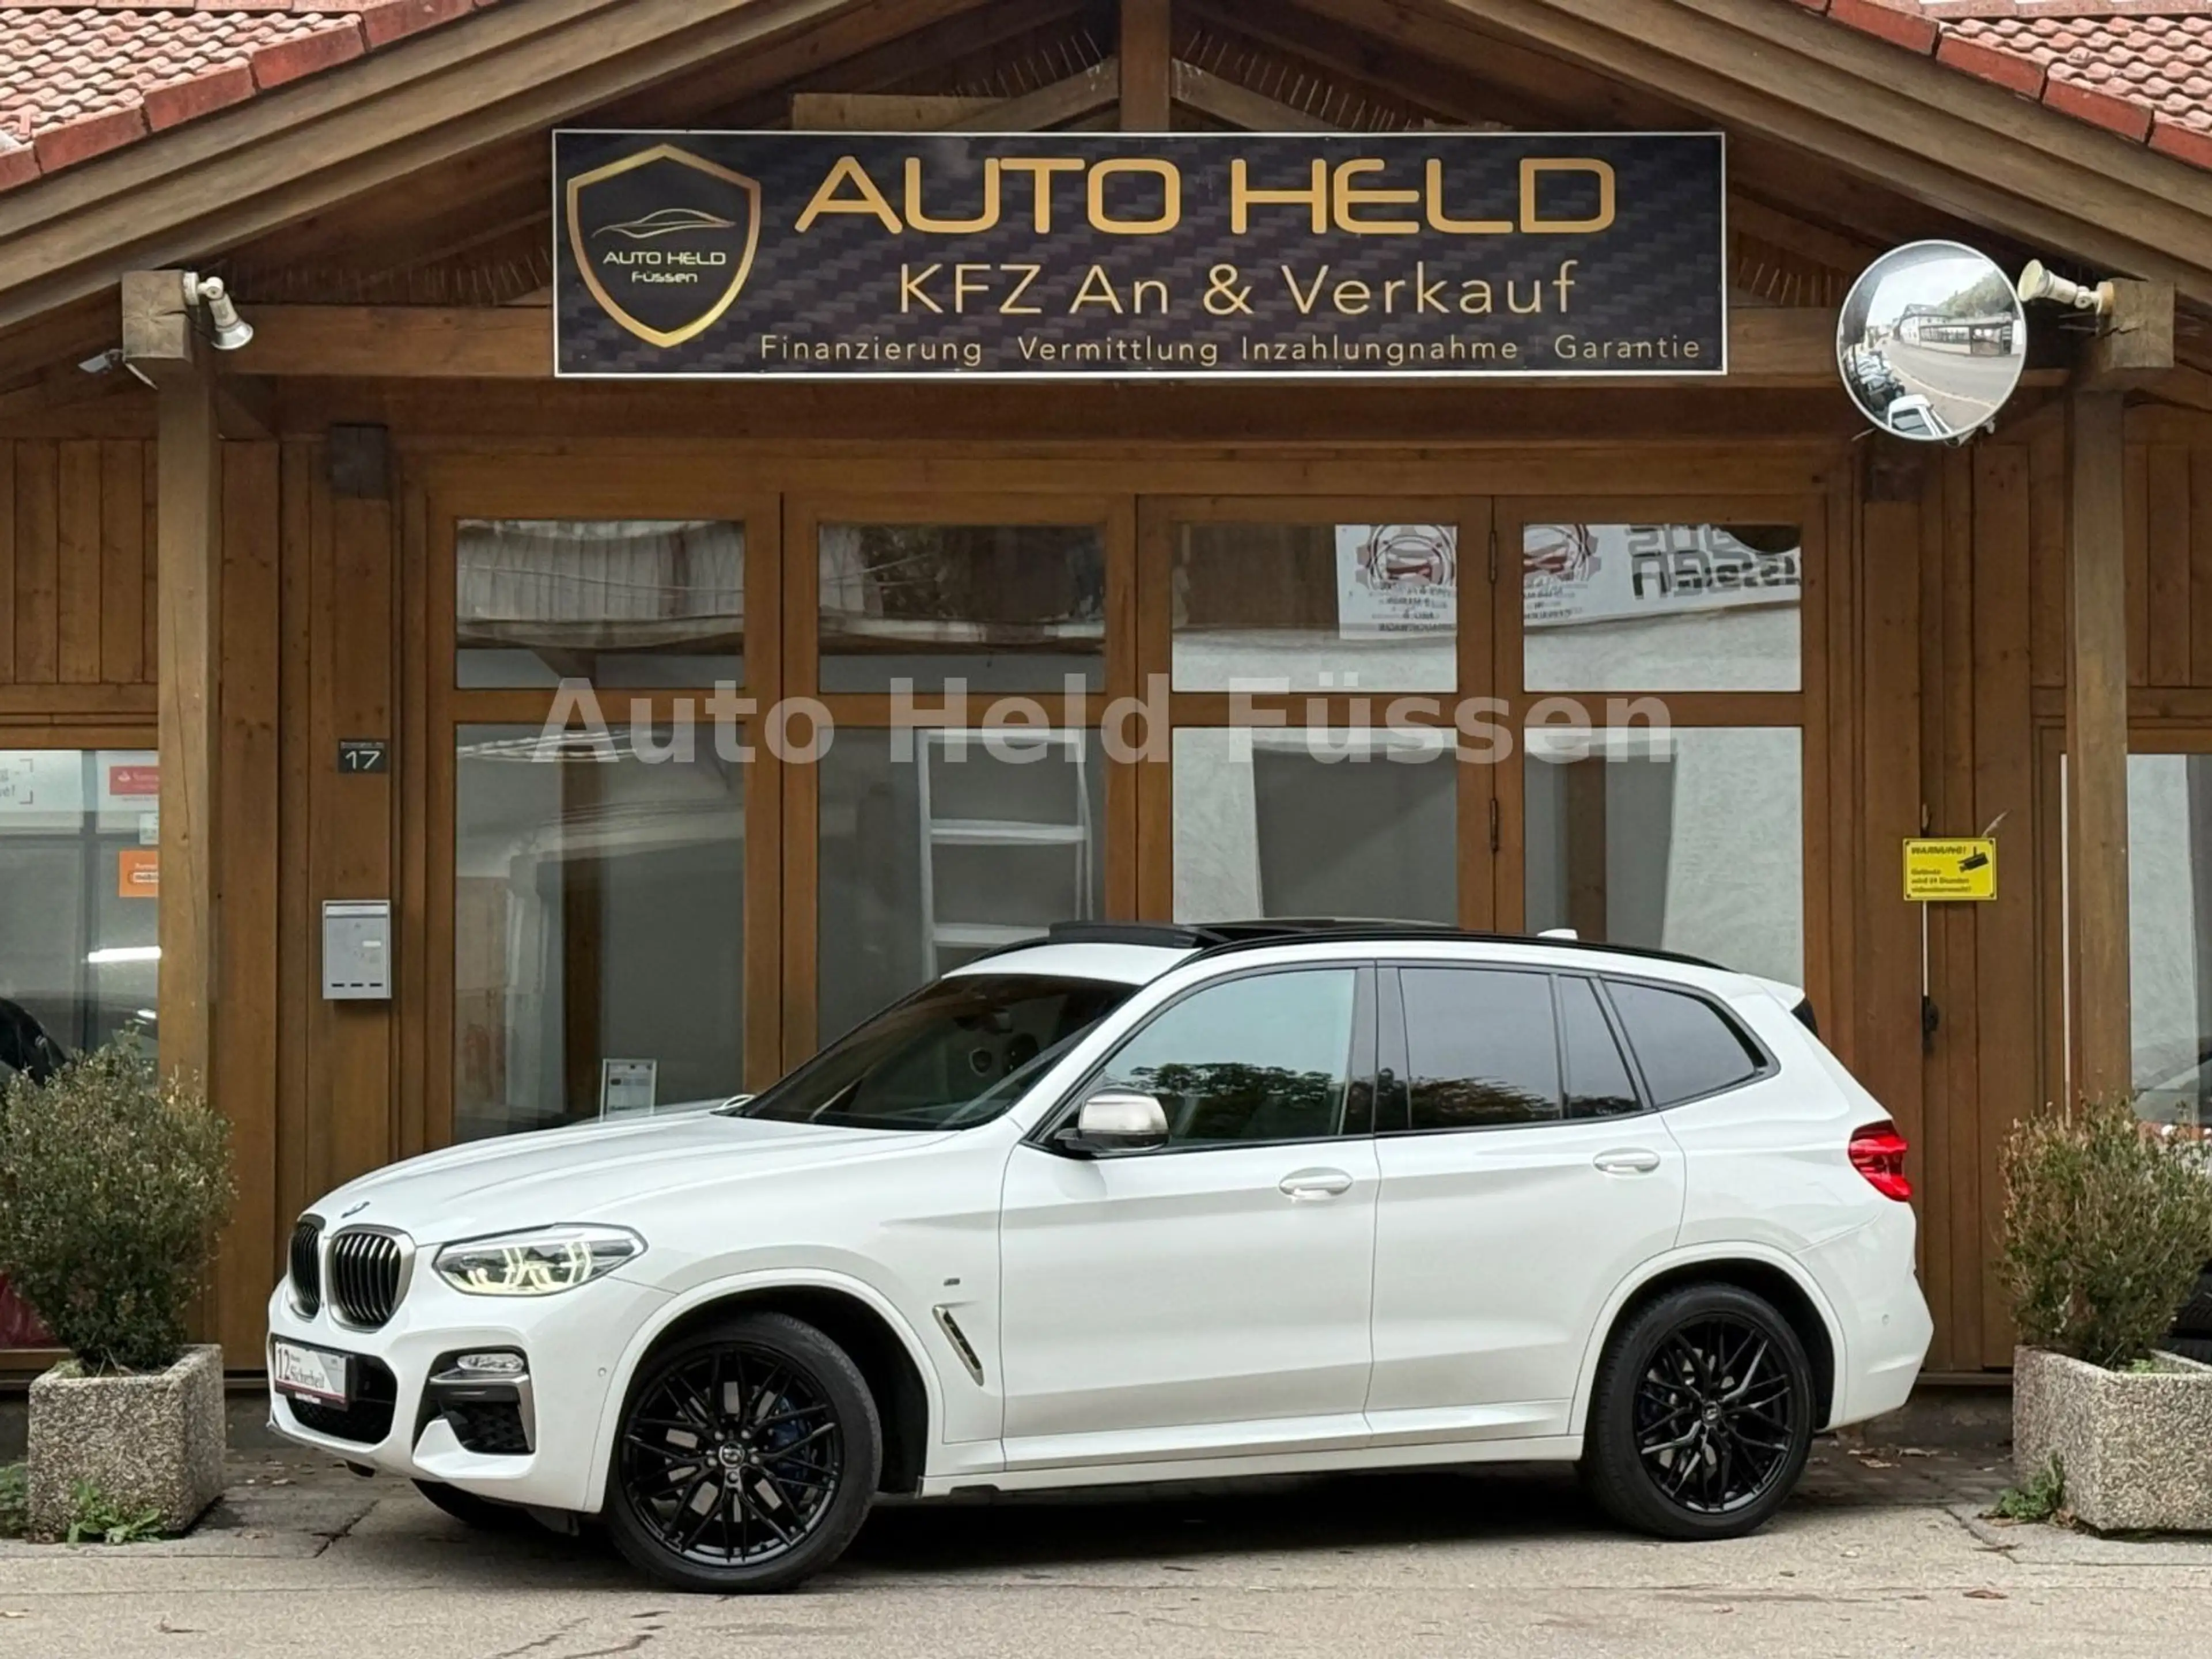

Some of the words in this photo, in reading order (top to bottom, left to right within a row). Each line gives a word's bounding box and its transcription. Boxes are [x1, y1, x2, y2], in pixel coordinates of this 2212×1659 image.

[794, 155, 1181, 234] AUTO
[1231, 157, 1615, 235] HELD
[603, 251, 662, 265] AUTO
[667, 251, 726, 266] HELD
[631, 270, 698, 283] Füssen
[900, 263, 1042, 314] KFZ
[1069, 263, 1168, 314] An
[1203, 263, 1254, 315] &
[1281, 260, 1579, 315] Verkauf
[761, 334, 982, 366] Finanzierung
[1017, 335, 1218, 366] Vermittlung
[1242, 334, 1518, 366] Inzahlungnahme
[1554, 334, 1700, 359] Garantie
[345, 750, 381, 770] 17
